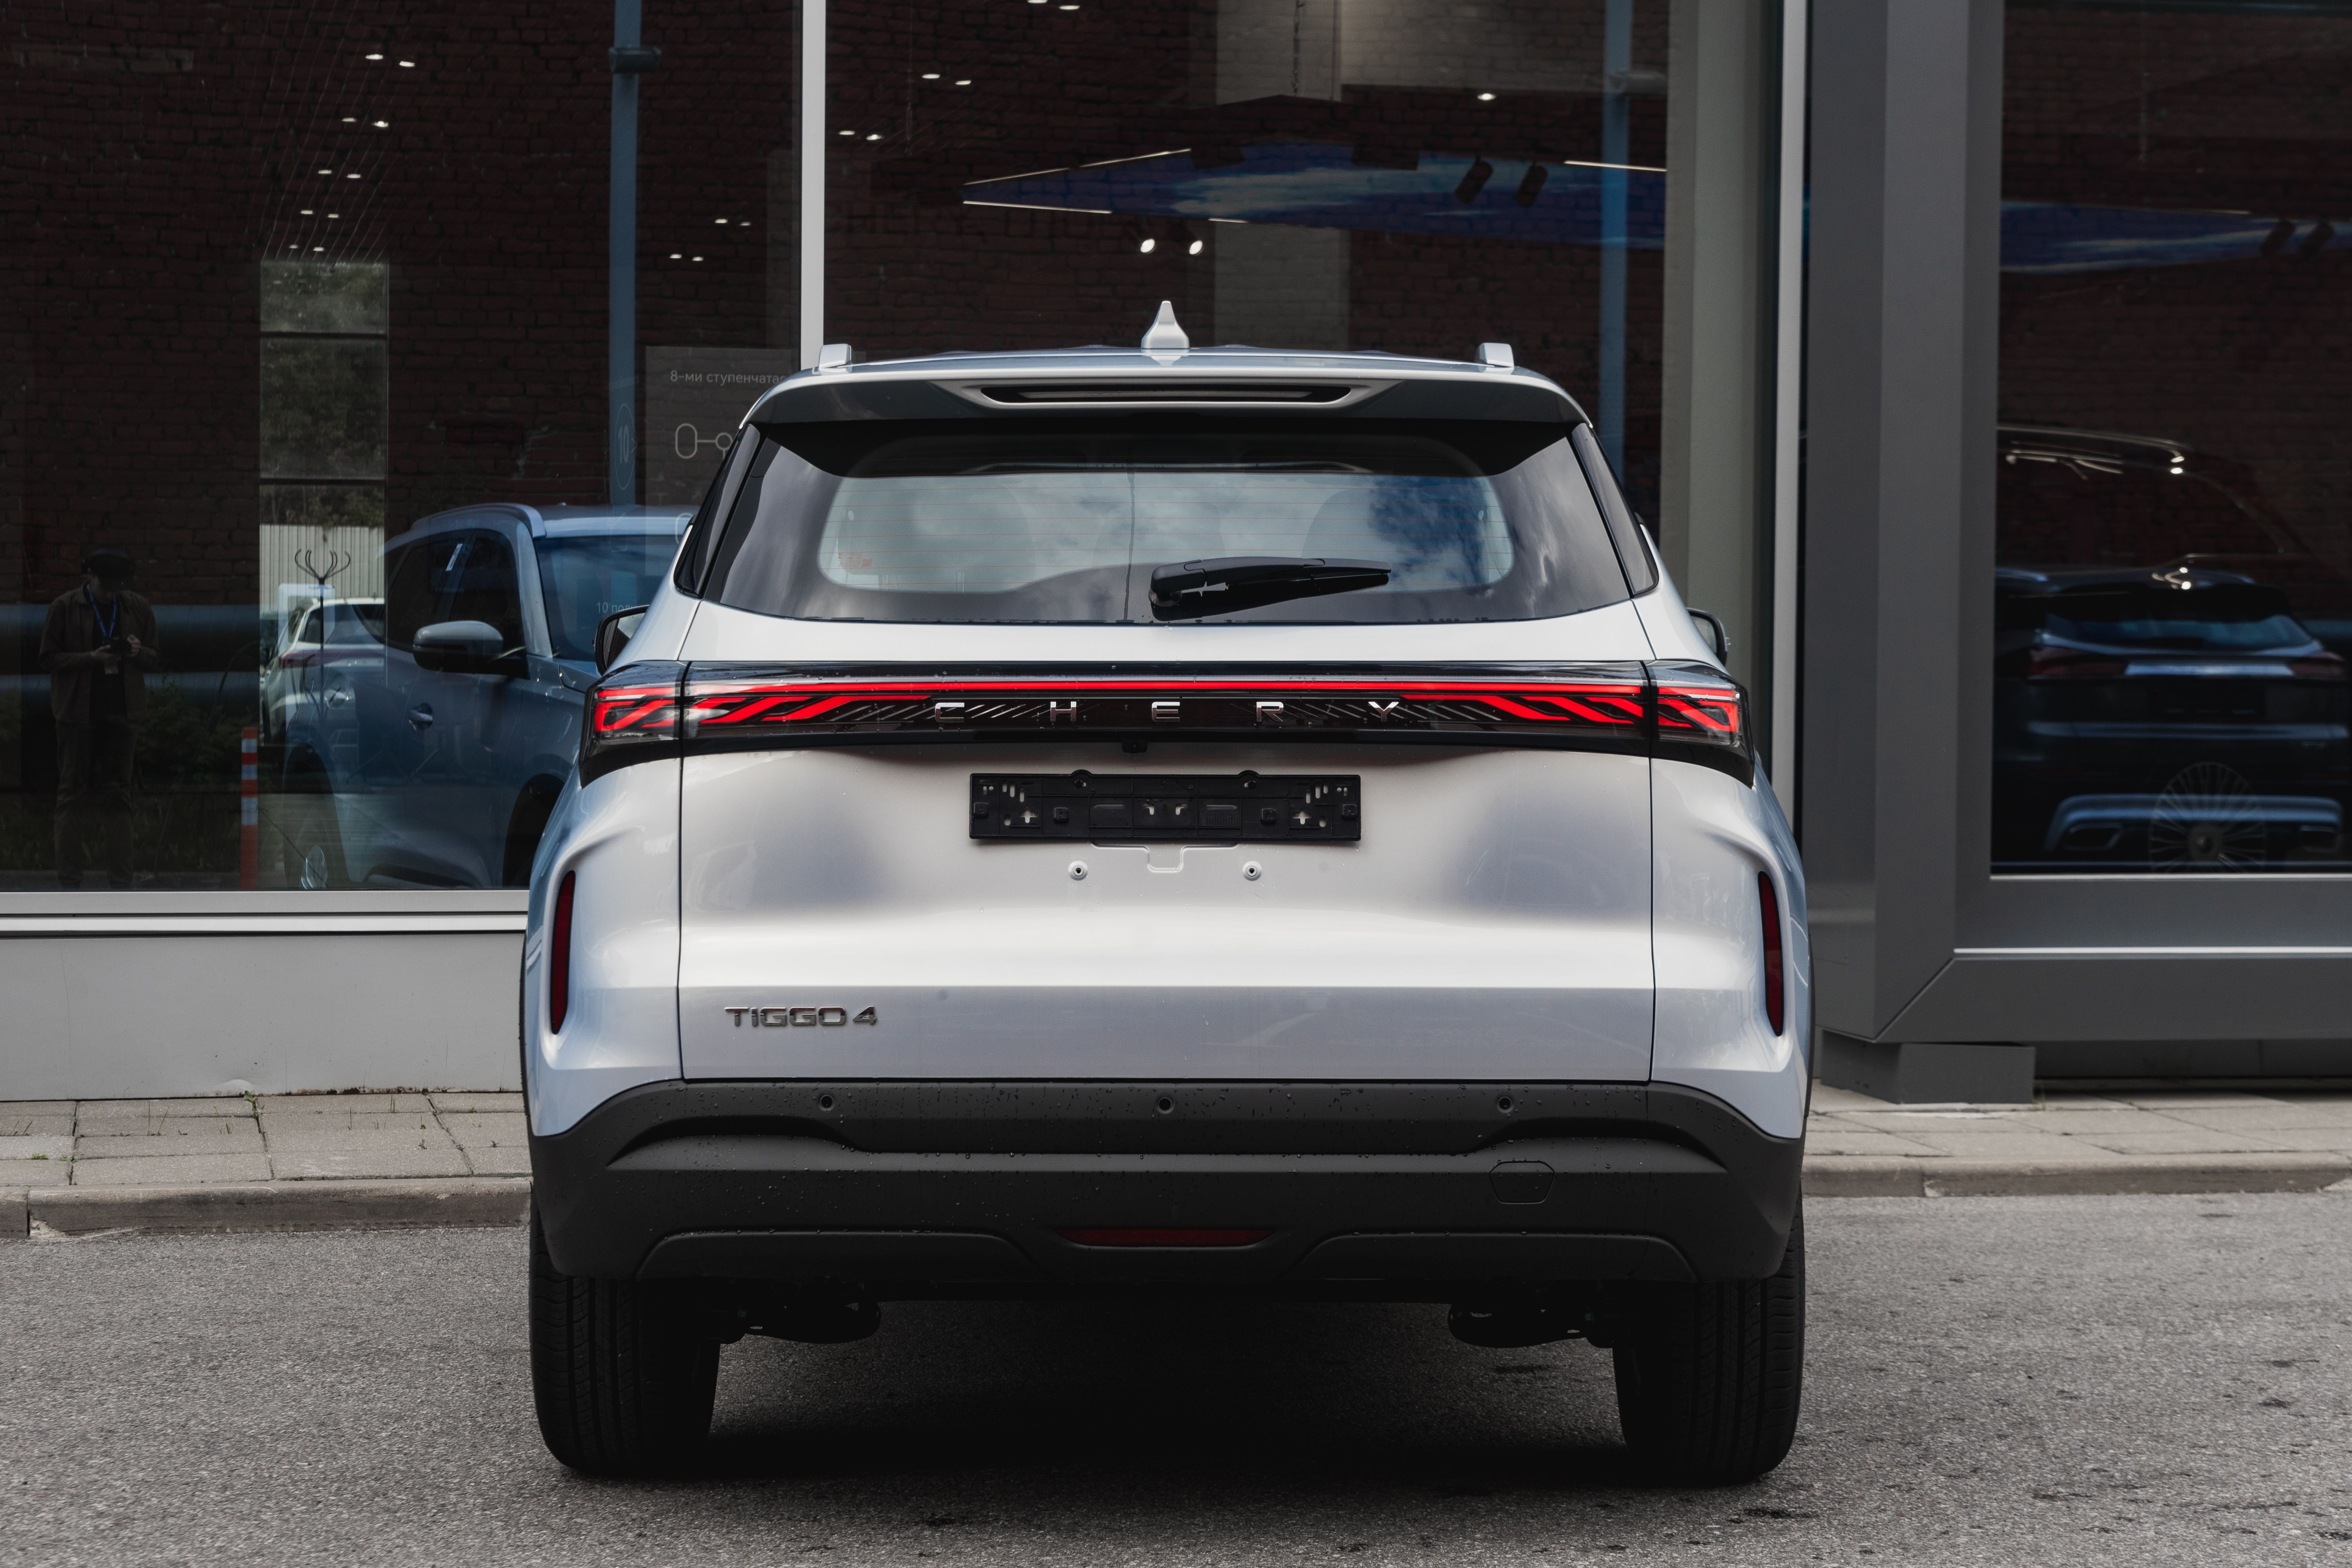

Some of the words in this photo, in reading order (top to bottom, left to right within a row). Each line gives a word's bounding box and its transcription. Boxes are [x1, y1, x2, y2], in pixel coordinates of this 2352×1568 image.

[670, 370, 702, 383] 8-ми
[596, 601, 608, 613] 10
[935, 701, 1399, 722] CHERY
[724, 1006, 846, 1026] TIGGO
[853, 1006, 877, 1025] 4
